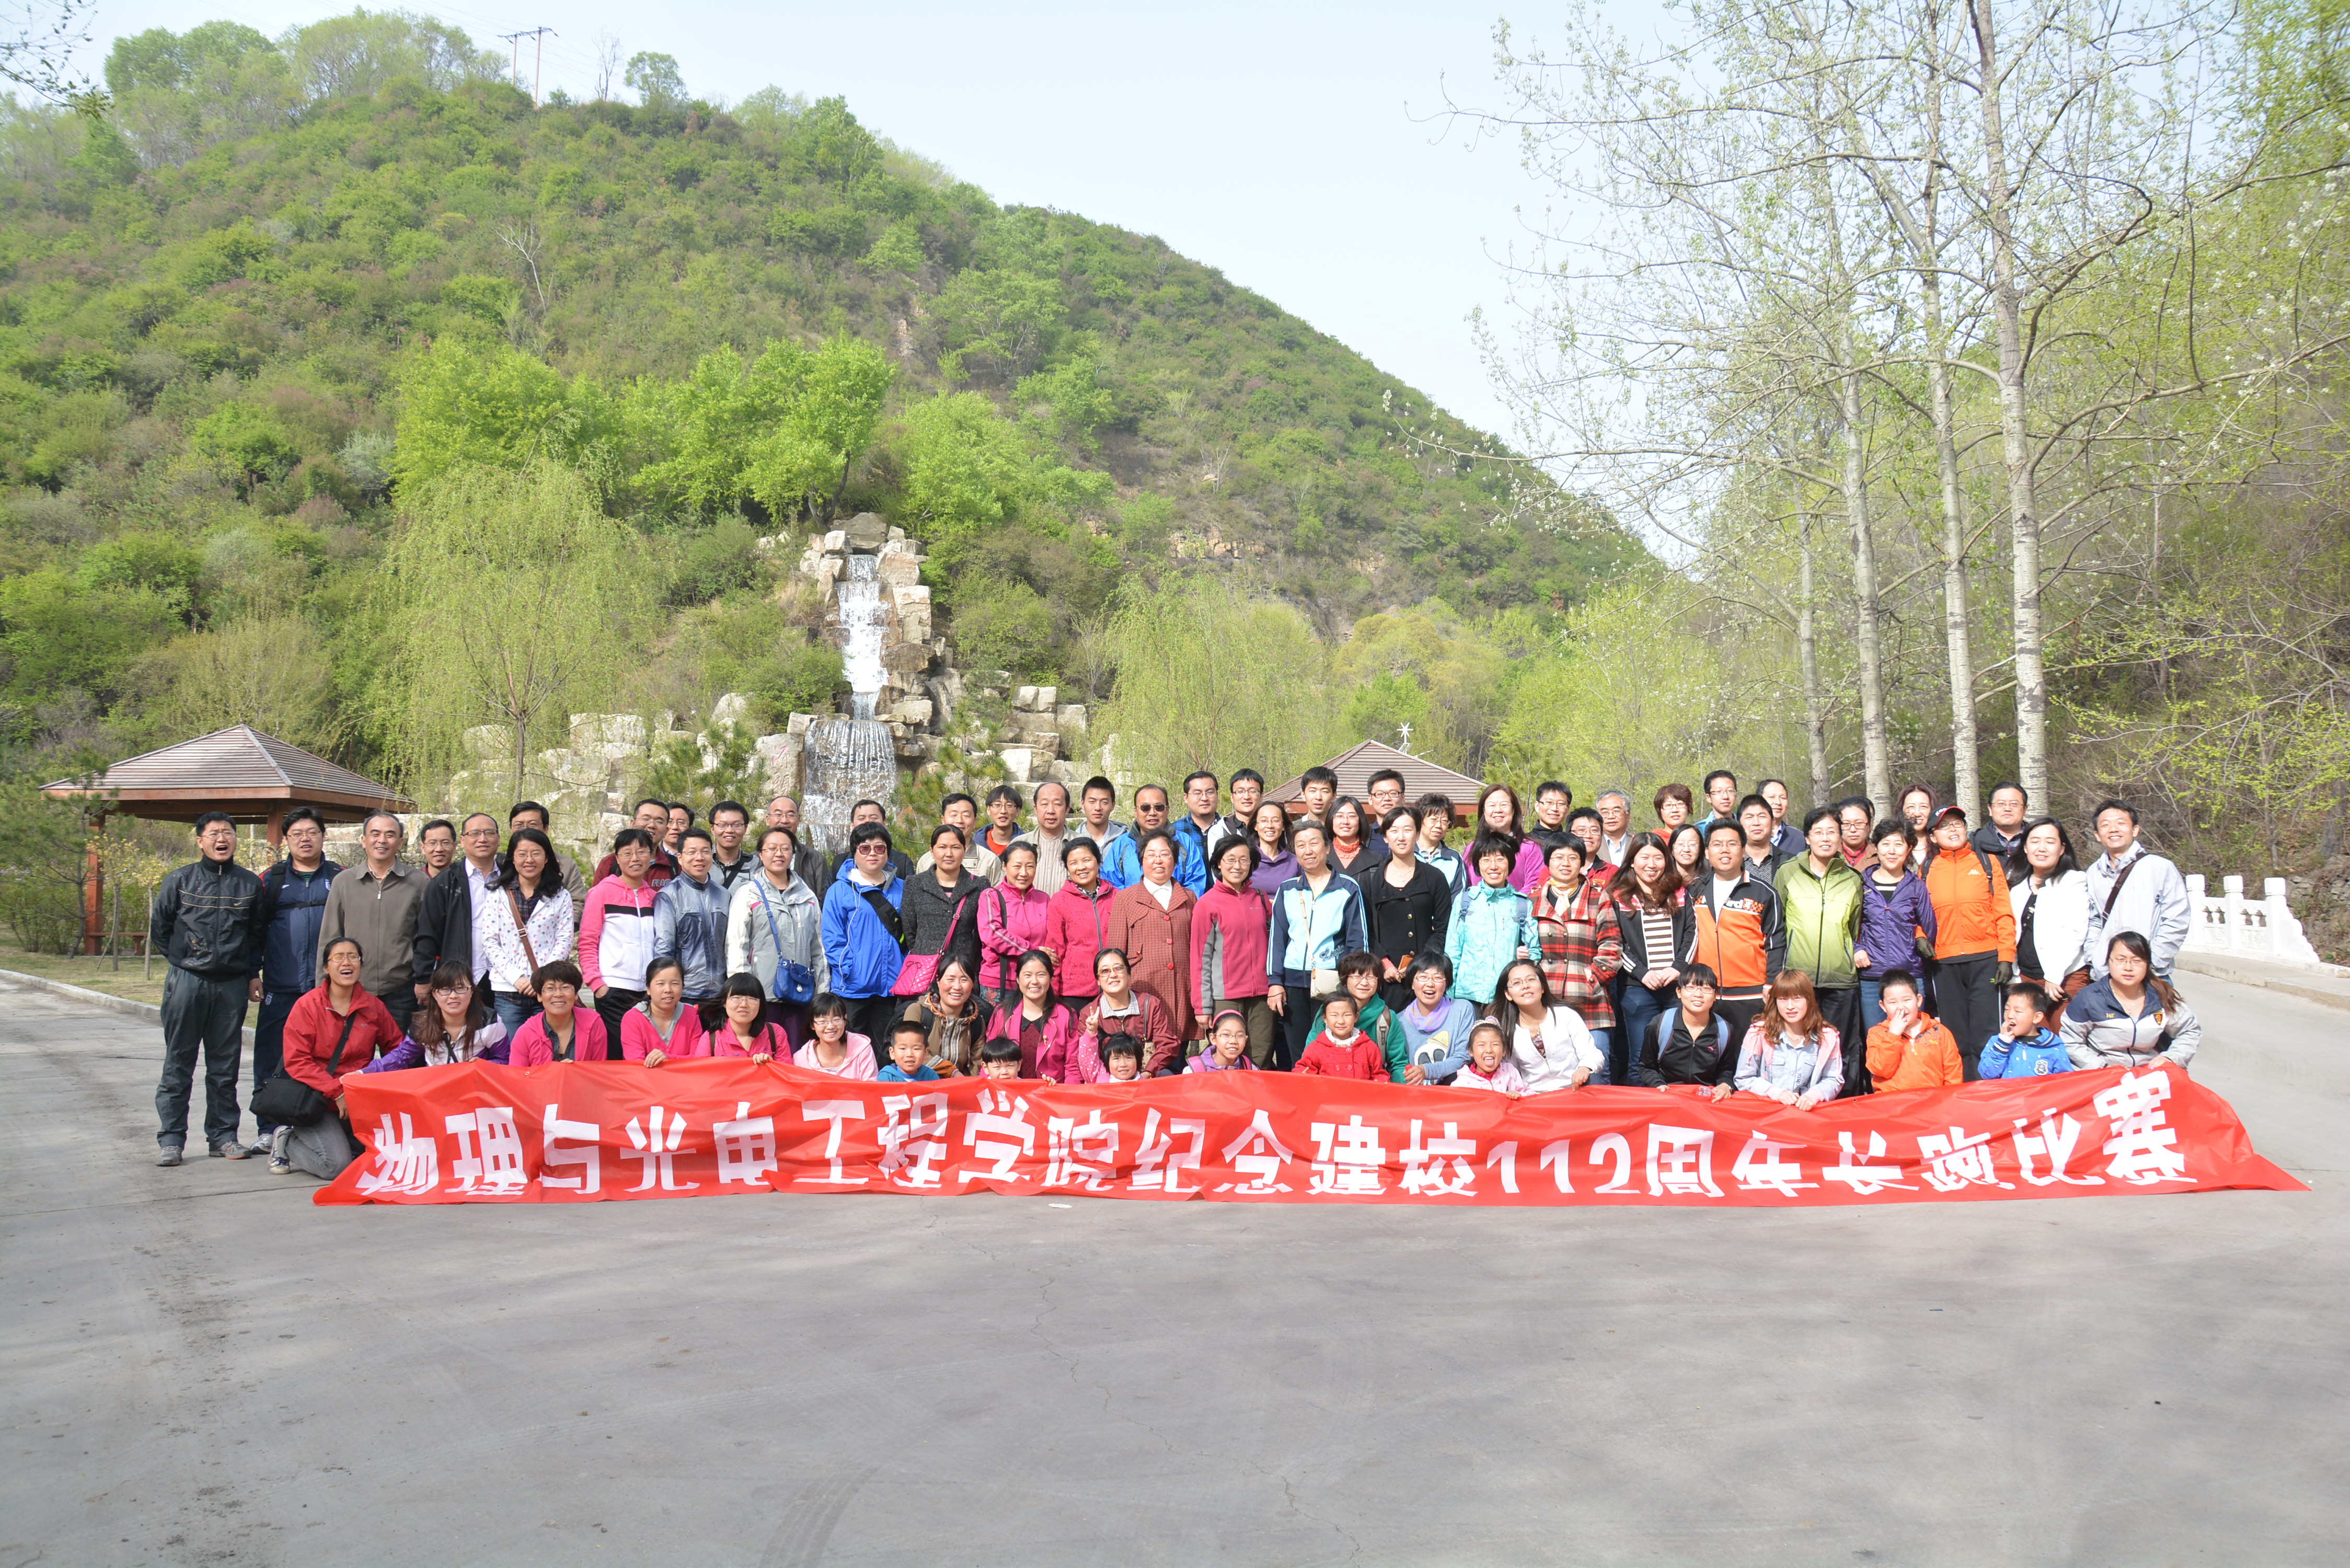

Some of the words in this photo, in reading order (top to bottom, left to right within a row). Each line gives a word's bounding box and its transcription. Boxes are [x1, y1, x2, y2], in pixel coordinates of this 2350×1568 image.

[355, 1070, 2198, 1197] 物理与光电工程学院纪念建校112周年长跑比赛
